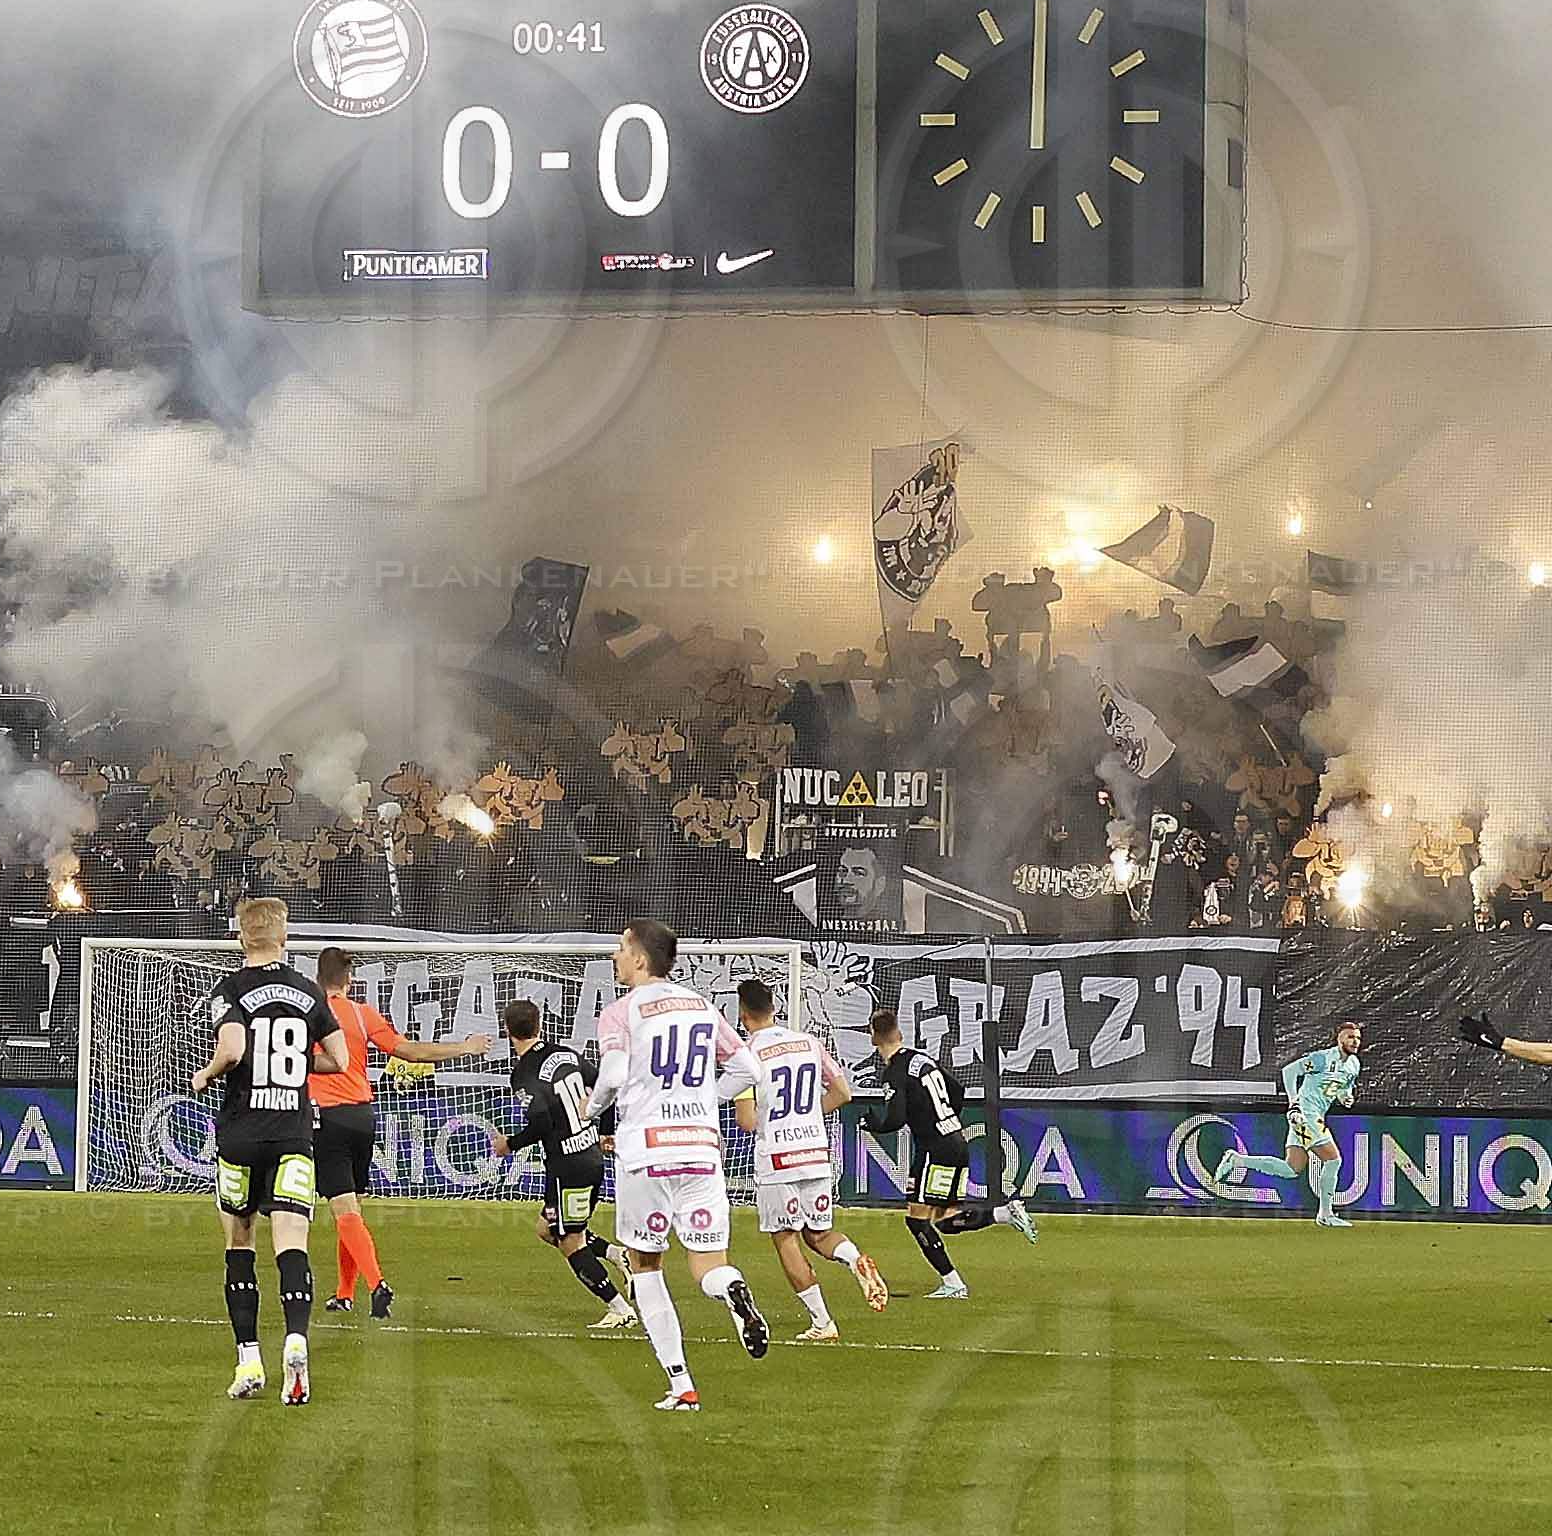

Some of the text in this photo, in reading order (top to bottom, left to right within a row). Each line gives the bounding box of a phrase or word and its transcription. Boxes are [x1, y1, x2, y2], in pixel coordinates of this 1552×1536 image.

[512, 22, 606, 55] 00:41
[712, 75, 795, 107] AUSTRIA WIEN
[442, 105, 513, 219] 0
[599, 102, 670, 217] 0
[353, 255, 479, 276] PUNTIGAMER
[244, 987, 311, 1010] PUNTIGAMER
[250, 1017, 308, 1088] 18
[651, 1023, 713, 1089] 46
[249, 1087, 299, 1111] MIKA
[768, 1063, 816, 1122] 30
